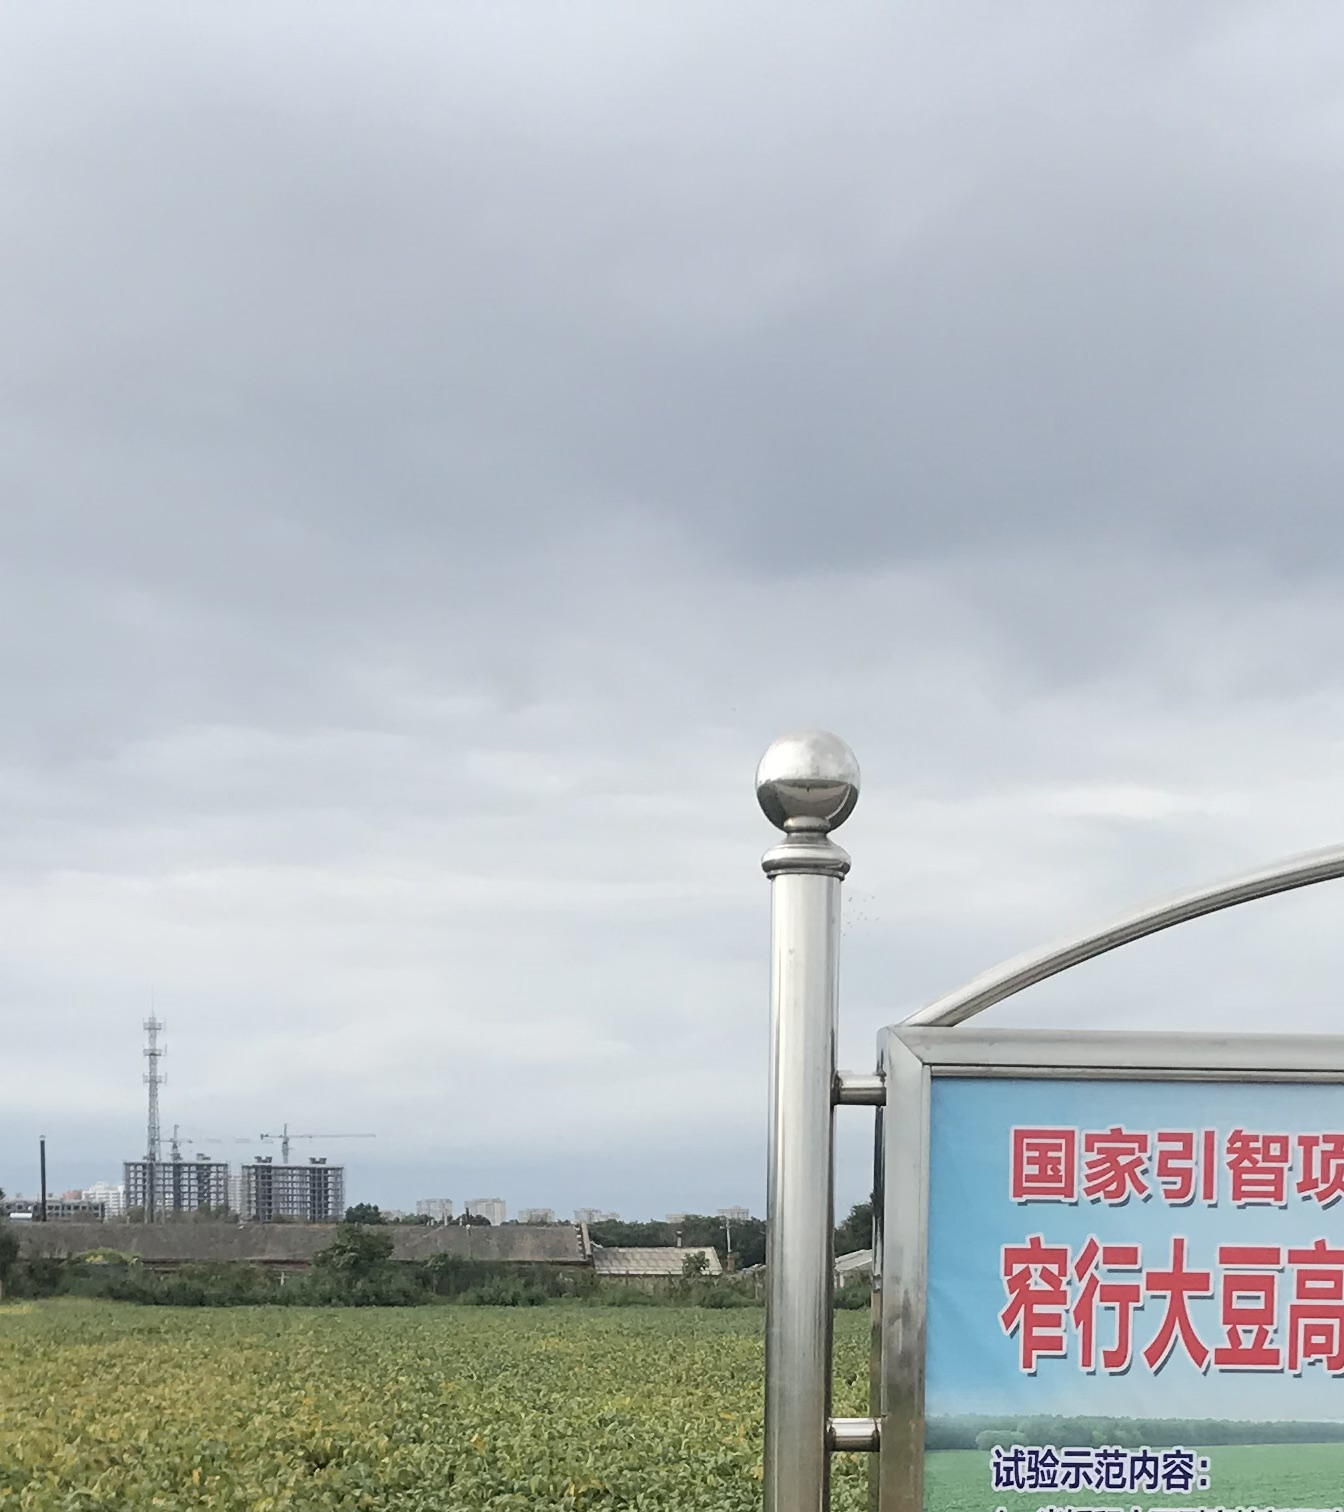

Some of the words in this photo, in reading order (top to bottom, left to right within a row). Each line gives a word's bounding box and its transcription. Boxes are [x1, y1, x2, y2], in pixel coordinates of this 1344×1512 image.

[992, 1448, 1208, 1491] 试验示范内容：
